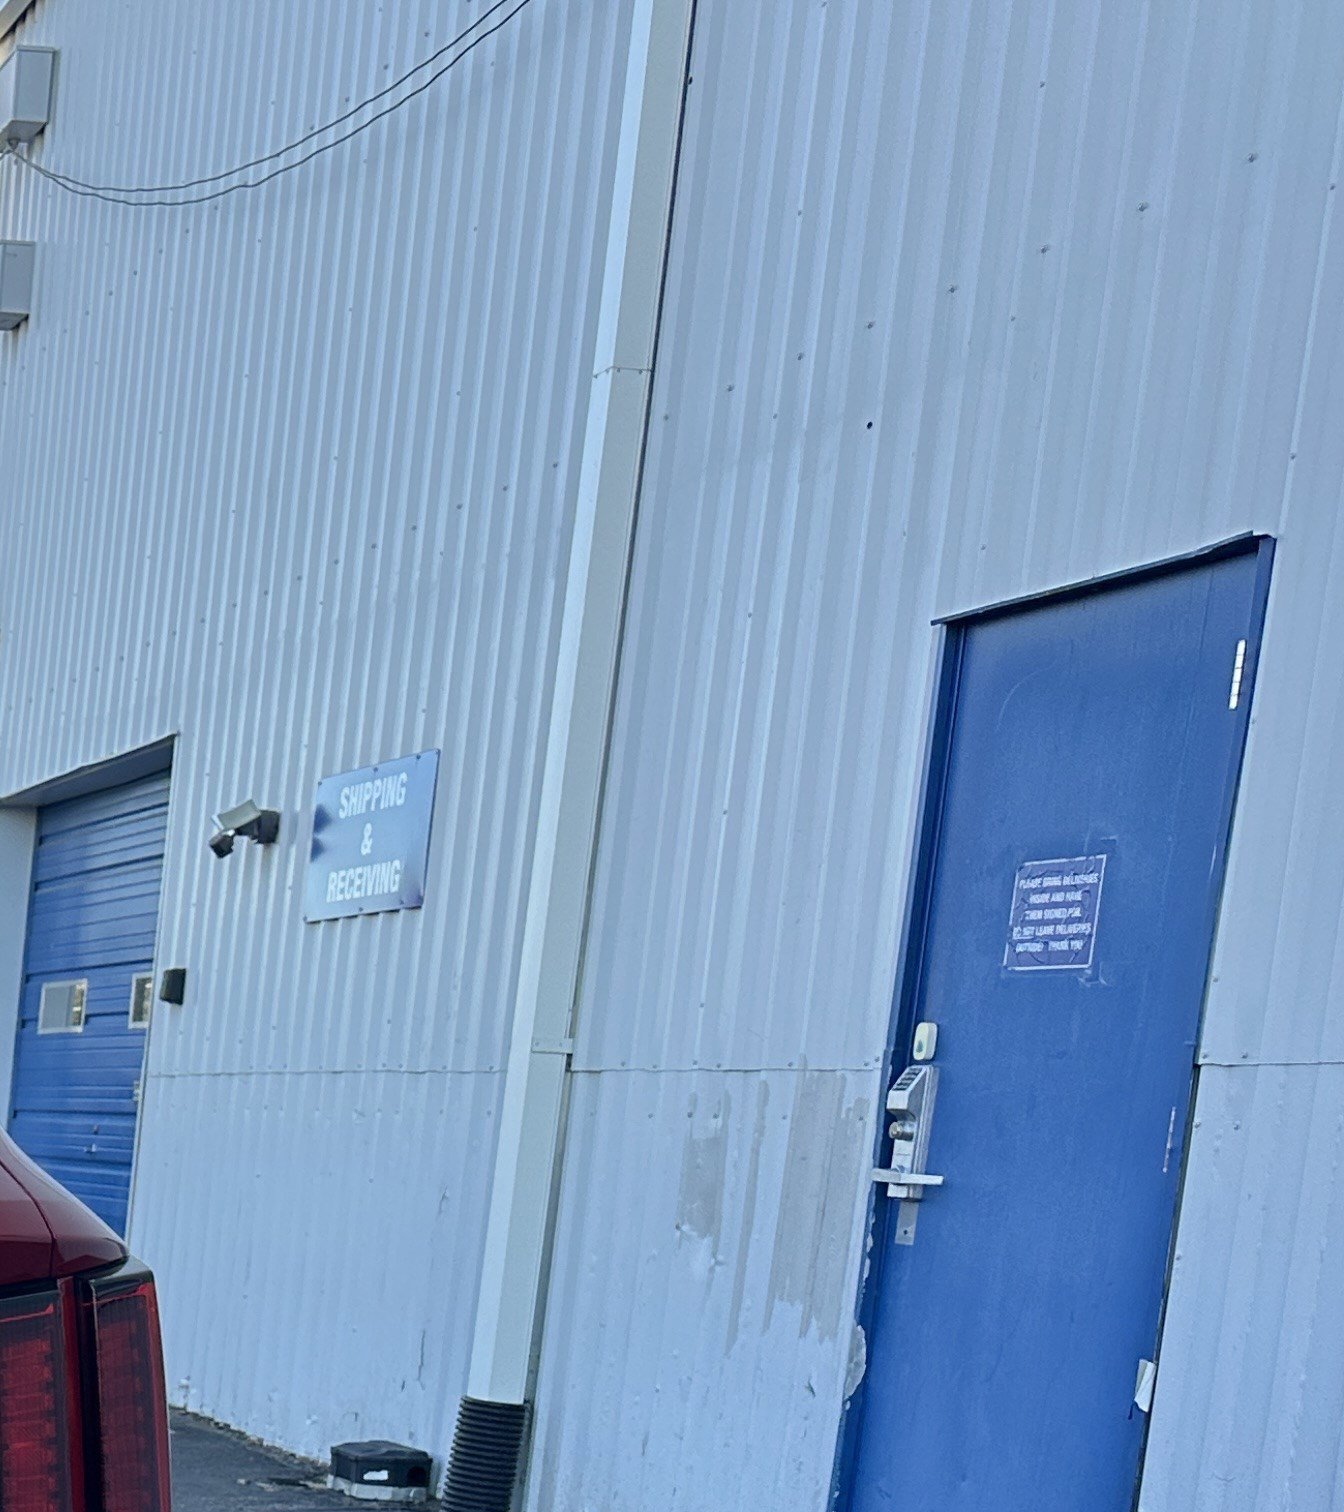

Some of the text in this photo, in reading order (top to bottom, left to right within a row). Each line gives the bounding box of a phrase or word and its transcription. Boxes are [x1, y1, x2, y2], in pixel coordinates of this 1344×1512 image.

[338, 771, 408, 820] SHIPPING
[360, 822, 373, 856] &
[325, 859, 402, 903] RECEIVING
